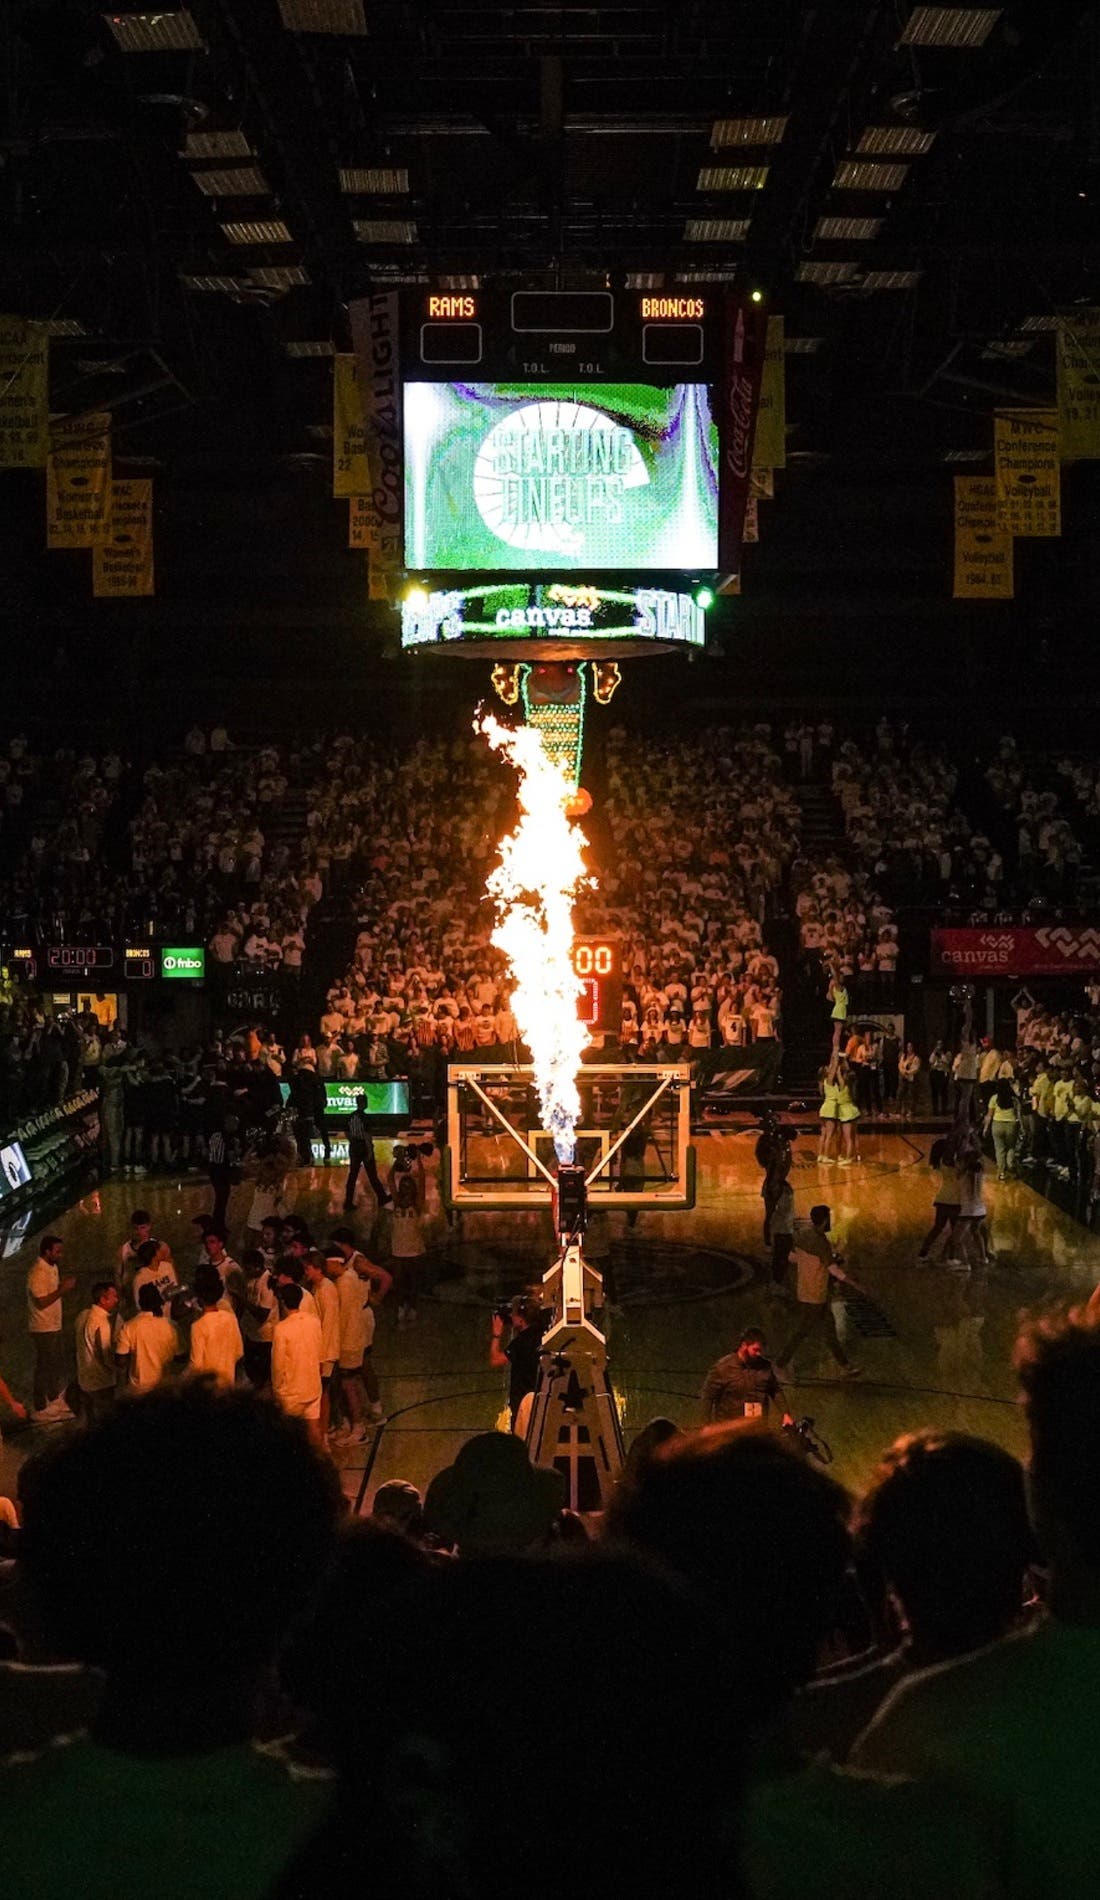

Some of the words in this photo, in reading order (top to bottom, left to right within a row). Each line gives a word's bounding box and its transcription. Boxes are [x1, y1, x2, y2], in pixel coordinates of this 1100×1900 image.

[429, 297, 475, 317] RAMS
[642, 298, 704, 318] BRONCOS
[370, 295, 394, 398] LIGHT
[549, 343, 576, 354] PERIOD
[727, 374, 752, 479] Coca-Cola
[492, 428, 636, 475] STARTING
[998, 439, 1056, 451] Conference
[1000, 458, 1054, 470] Champions
[502, 475, 625, 525] LINEUPS
[496, 605, 592, 627] canvas
[177, 958, 202, 968] fnbo
[941, 950, 1009, 963] canvas
